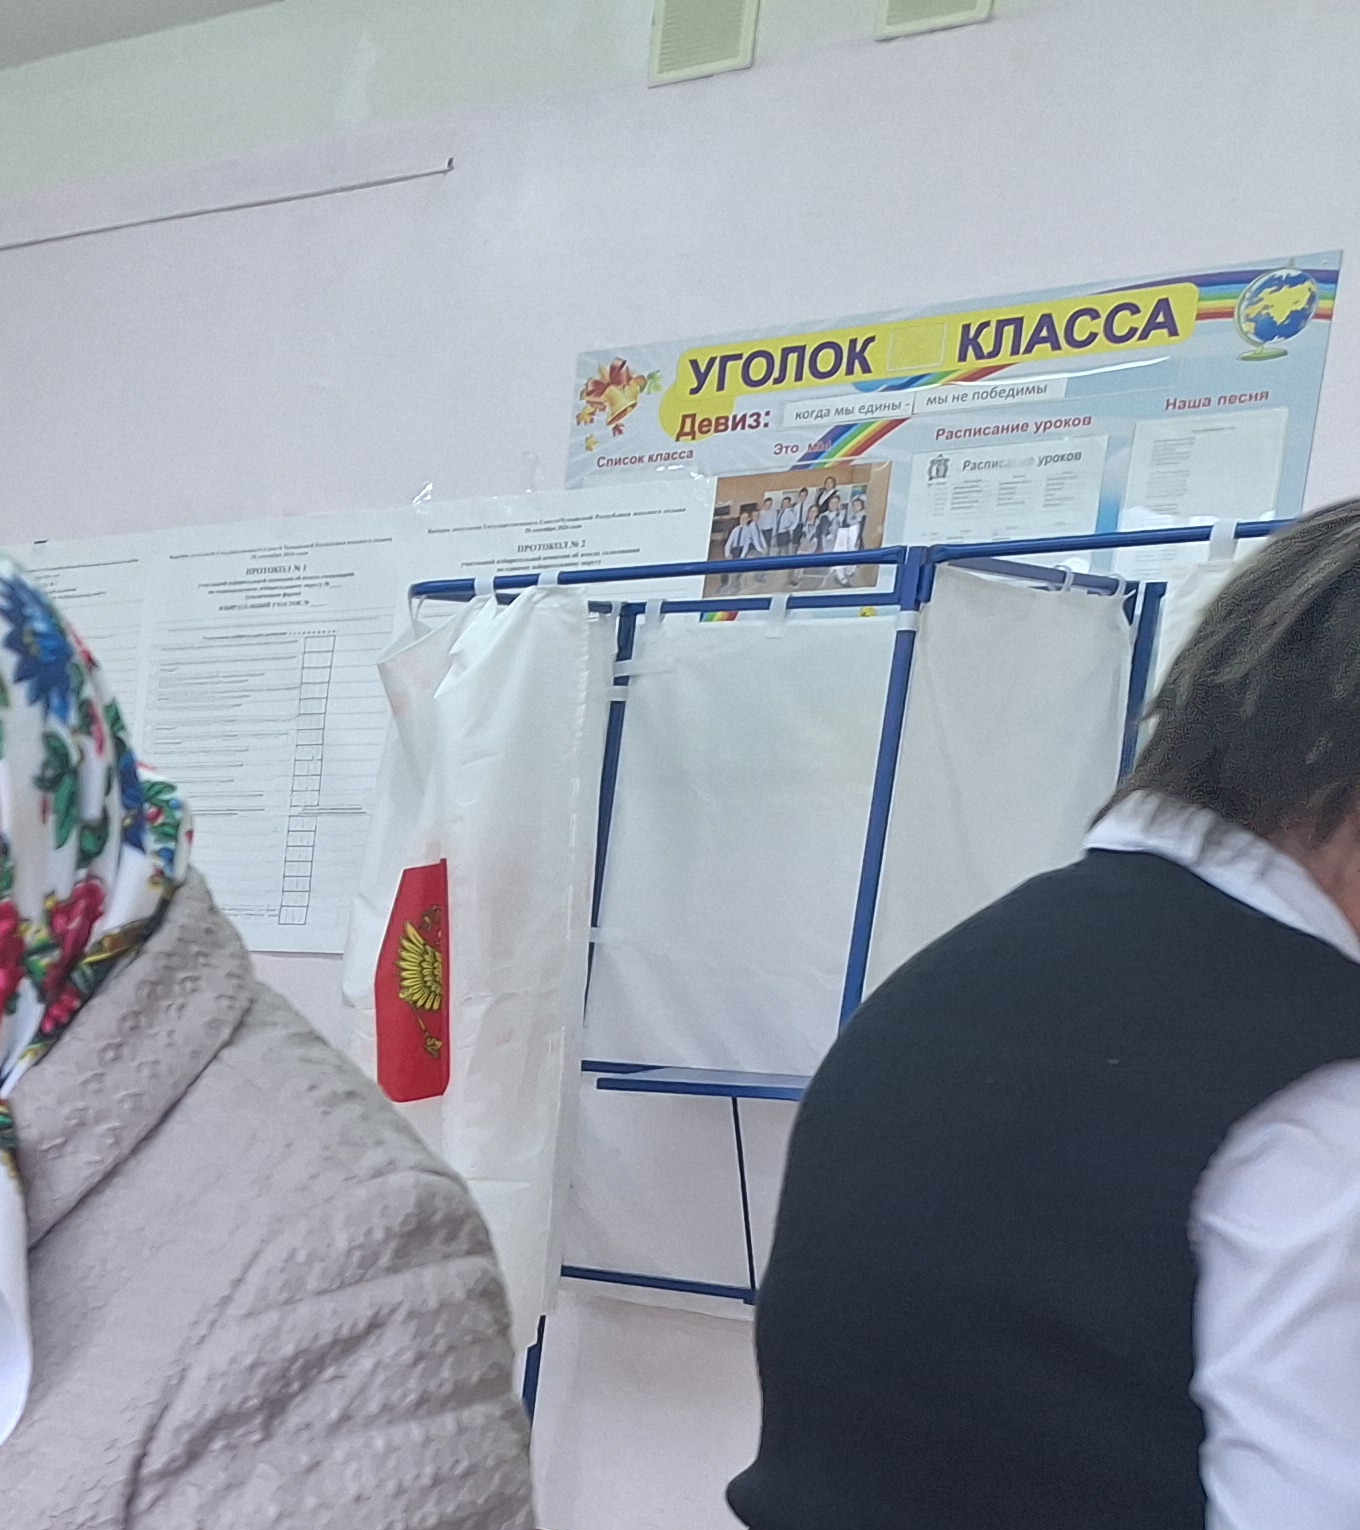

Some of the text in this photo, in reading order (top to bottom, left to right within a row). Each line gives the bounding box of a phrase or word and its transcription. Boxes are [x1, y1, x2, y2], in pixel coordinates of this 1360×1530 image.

[688, 297, 1180, 395] УГОЛОК КЛАССА
[795, 407, 830, 421] когда
[834, 405, 854, 417] мы
[858, 401, 901, 415] едины
[926, 393, 947, 406] мы
[951, 391, 968, 403] не
[972, 383, 1047, 401] победимы
[1165, 390, 1270, 411] Наша песня
[675, 410, 771, 442] Девиз:
[935, 415, 1092, 441] Расписание уроков
[597, 450, 694, 468] Список класса
[773, 443, 799, 456] Это
[1037, 451, 1082, 467] уроков
